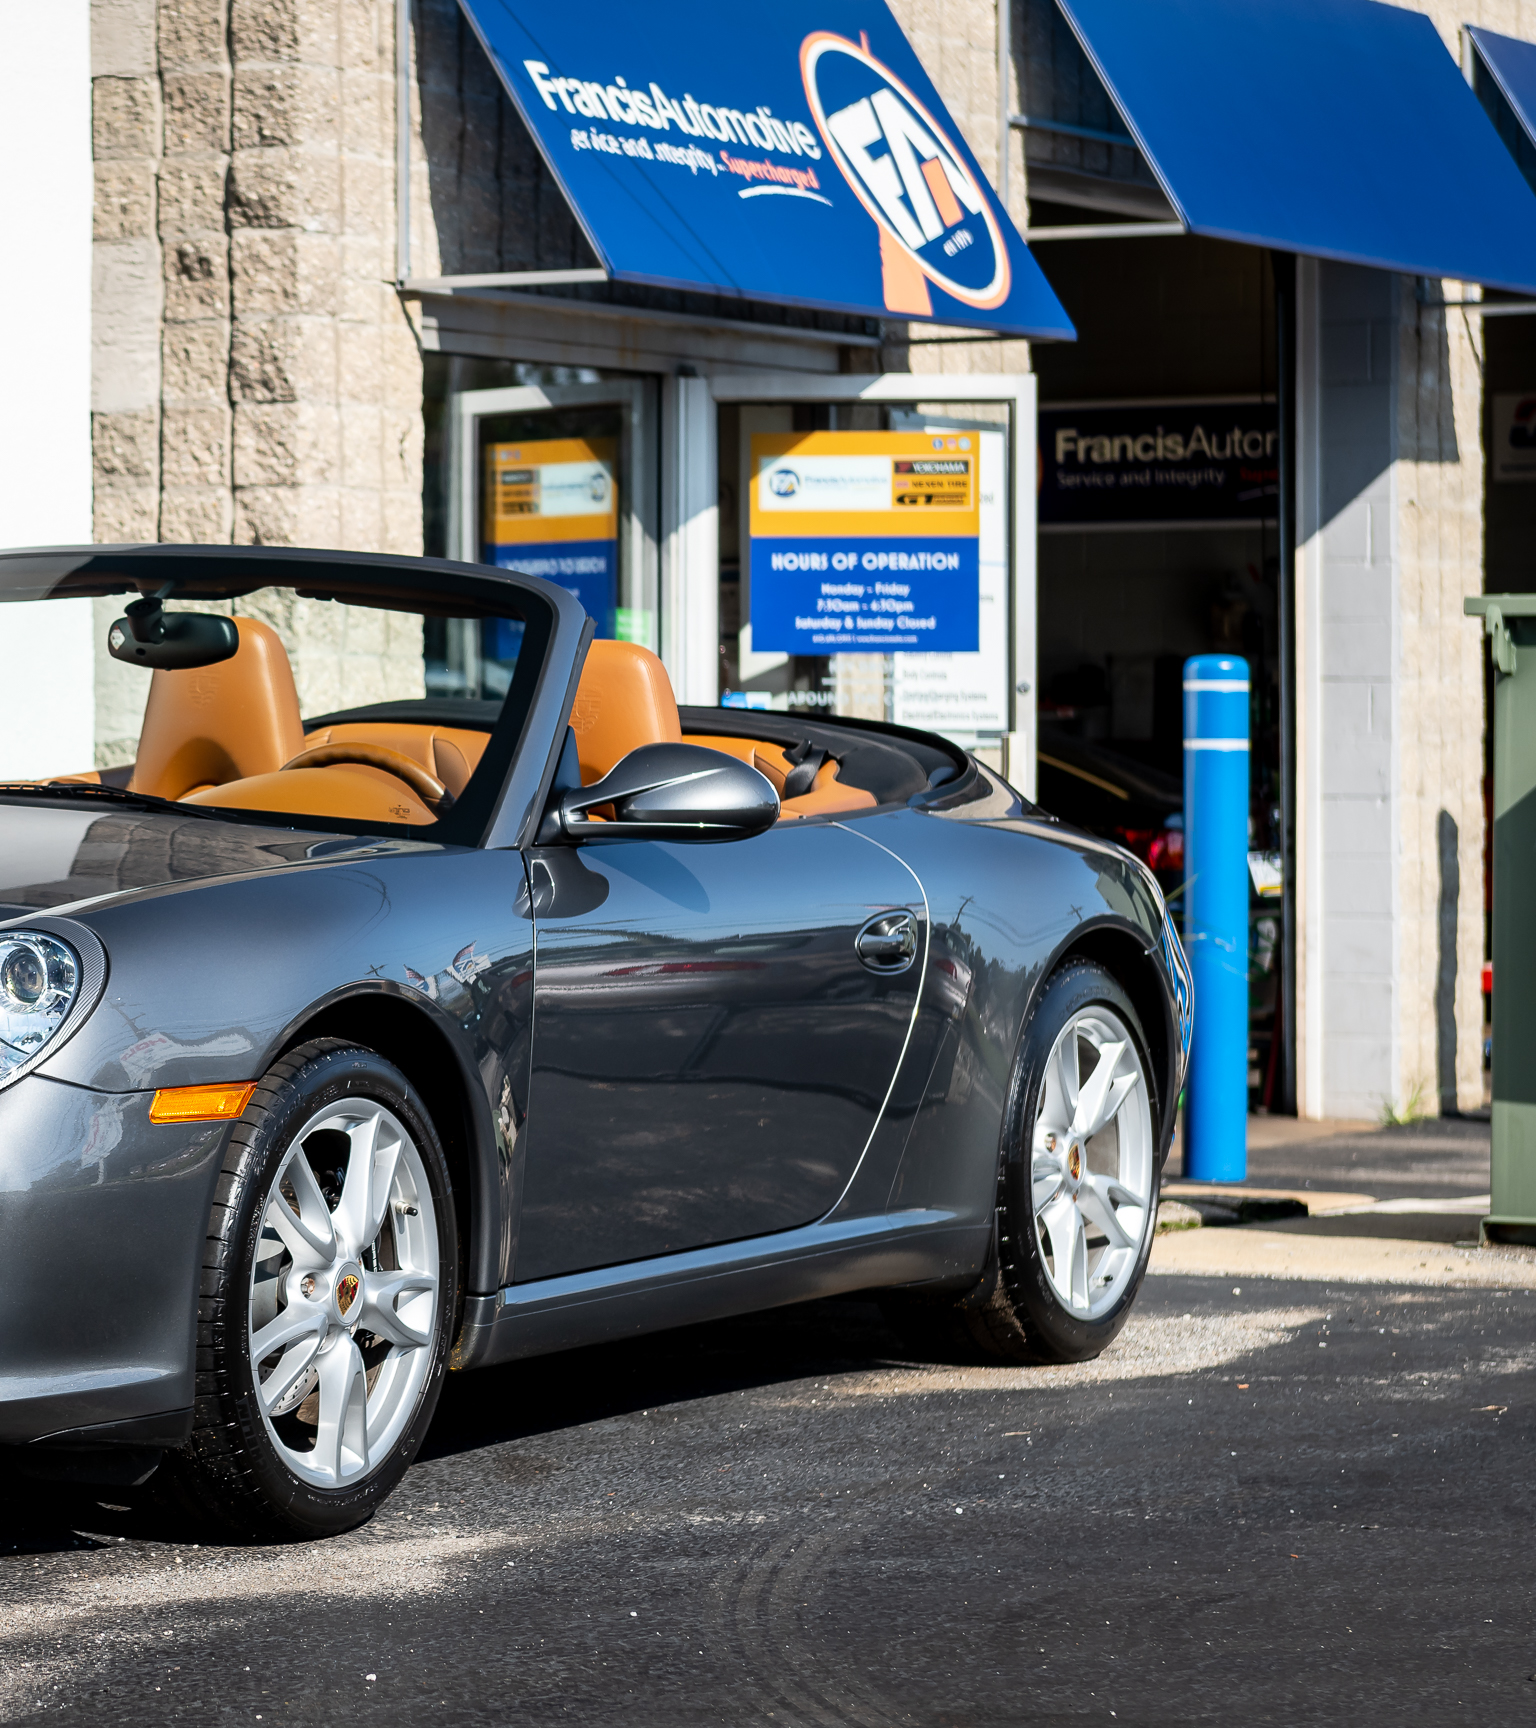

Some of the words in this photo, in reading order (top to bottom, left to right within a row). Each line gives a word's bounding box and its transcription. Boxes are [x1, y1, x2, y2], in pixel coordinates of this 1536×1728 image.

[719, 149, 821, 190] Supercharged
[912, 461, 966, 474] YOKOHAMA
[912, 480, 944, 489] NEXEN
[947, 480, 968, 489] TIRE
[1056, 467, 1116, 490] Service
[1119, 467, 1152, 487] and
[1155, 466, 1226, 490] Integrity
[771, 552, 828, 571] HOURS
[831, 552, 859, 571] OF
[862, 552, 960, 571] OPERATION
[821, 582, 865, 598] Monday
[875, 581, 911, 598] Friday
[817, 598, 860, 613] 7:30am
[795, 615, 843, 632] Saturday
[856, 615, 895, 632] Sunday
[896, 615, 937, 630] Closed
